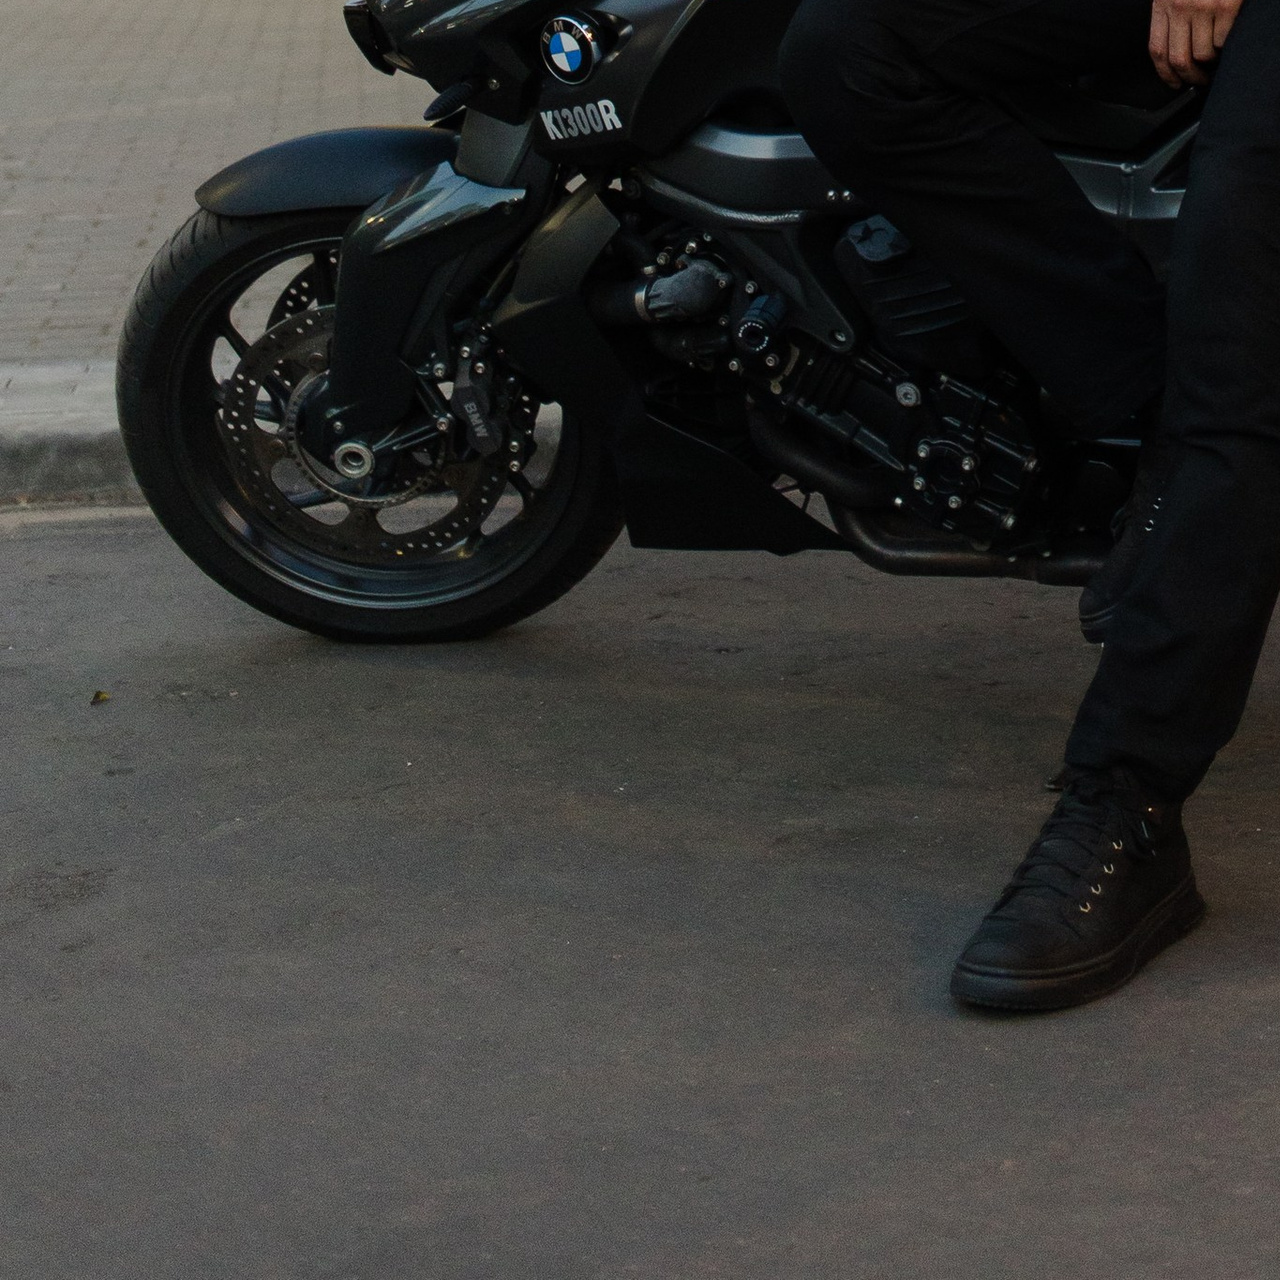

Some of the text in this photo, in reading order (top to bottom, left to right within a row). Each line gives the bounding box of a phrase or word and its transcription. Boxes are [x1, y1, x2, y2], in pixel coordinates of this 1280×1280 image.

[542, 21, 583, 45] BMW
[540, 99, 622, 140] K1300R
[464, 402, 489, 438] BMW
